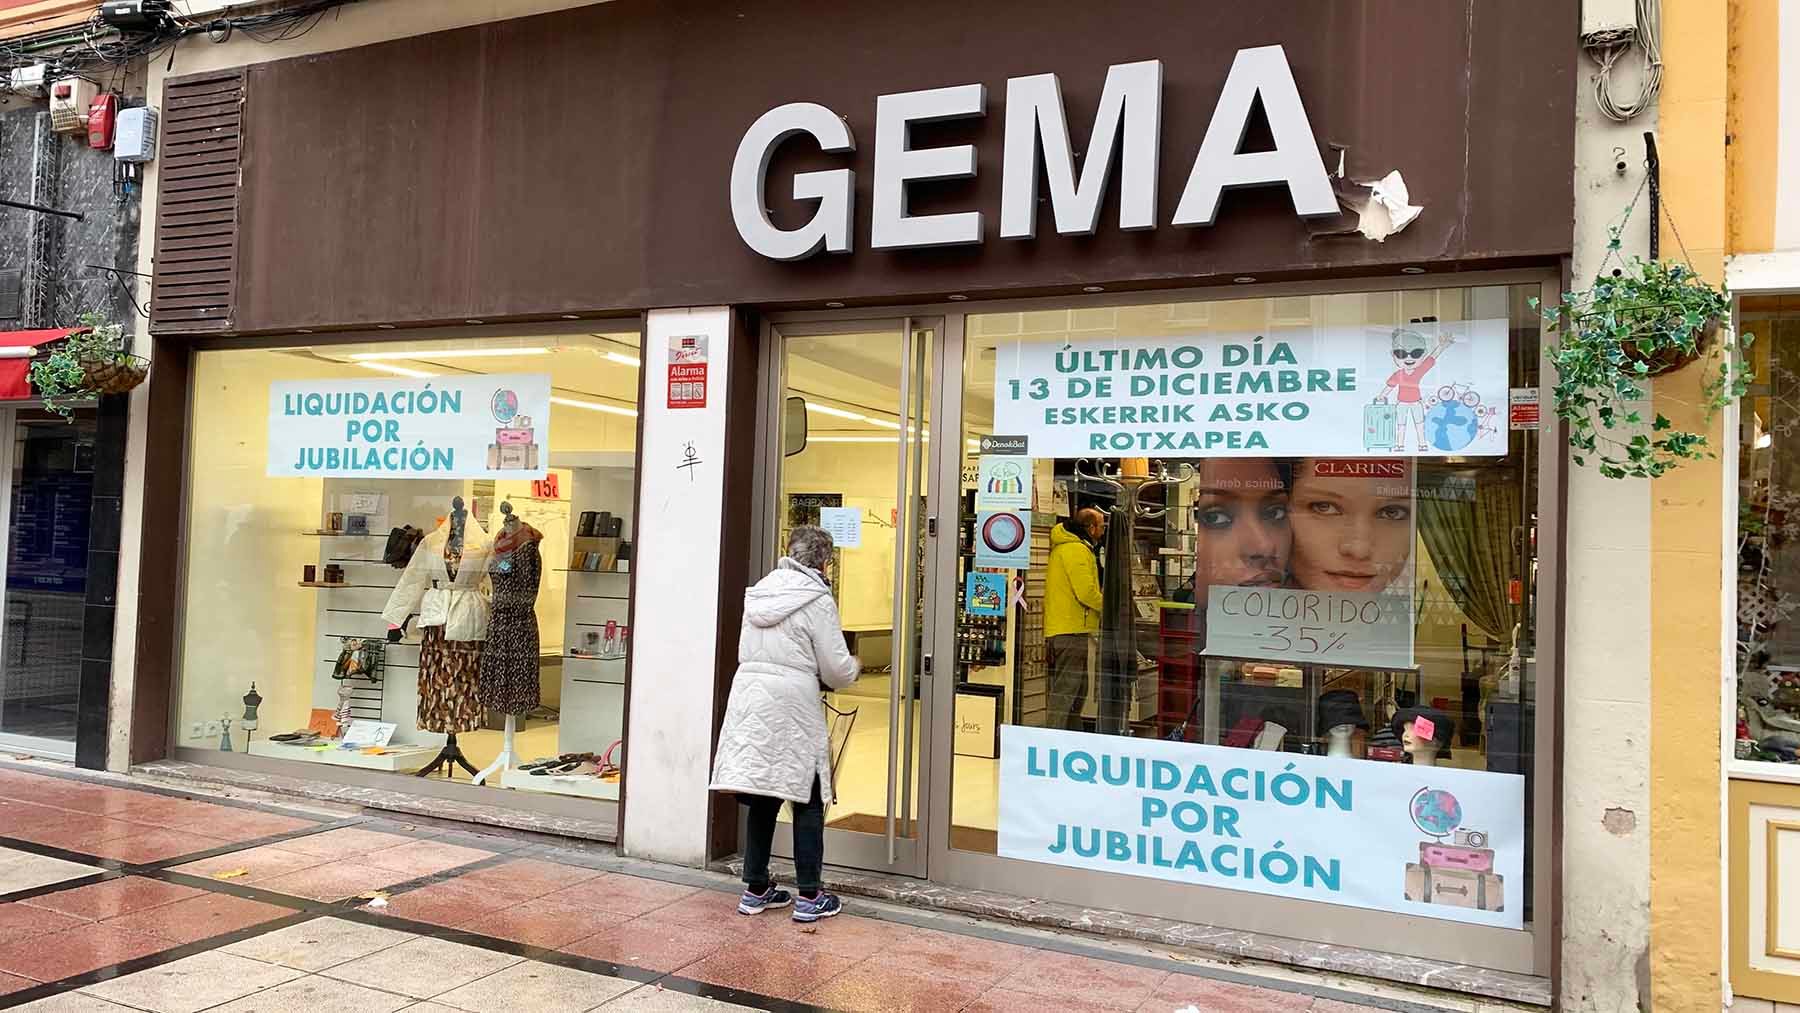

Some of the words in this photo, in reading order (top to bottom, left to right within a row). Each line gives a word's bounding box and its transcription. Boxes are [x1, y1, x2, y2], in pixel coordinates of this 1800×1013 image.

[730, 44, 1340, 262] GEMA
[1055, 343, 1202, 374] ÚLTIMO
[1224, 334, 1297, 369] DÍA
[671, 366, 705, 376] Alarma
[1009, 377, 1049, 401] 13
[1066, 376, 1114, 401] DE
[1129, 367, 1357, 398] DICIEMBRE
[283, 384, 461, 417] LIQUIDACIÓN
[1043, 405, 1193, 427] ESKERRIK
[1206, 402, 1312, 423] ASKO
[345, 418, 401, 443] POR
[1088, 430, 1270, 452] ROTXAPEA
[293, 440, 455, 472] JUBILACIÓN
[1315, 461, 1405, 475] CLARINS
[1253, 625, 1347, 654] -35%
[1026, 745, 1354, 812] LIQUIDACIÓN
[1141, 796, 1241, 839] POR
[1047, 822, 1342, 893] JUBILACIÓN
